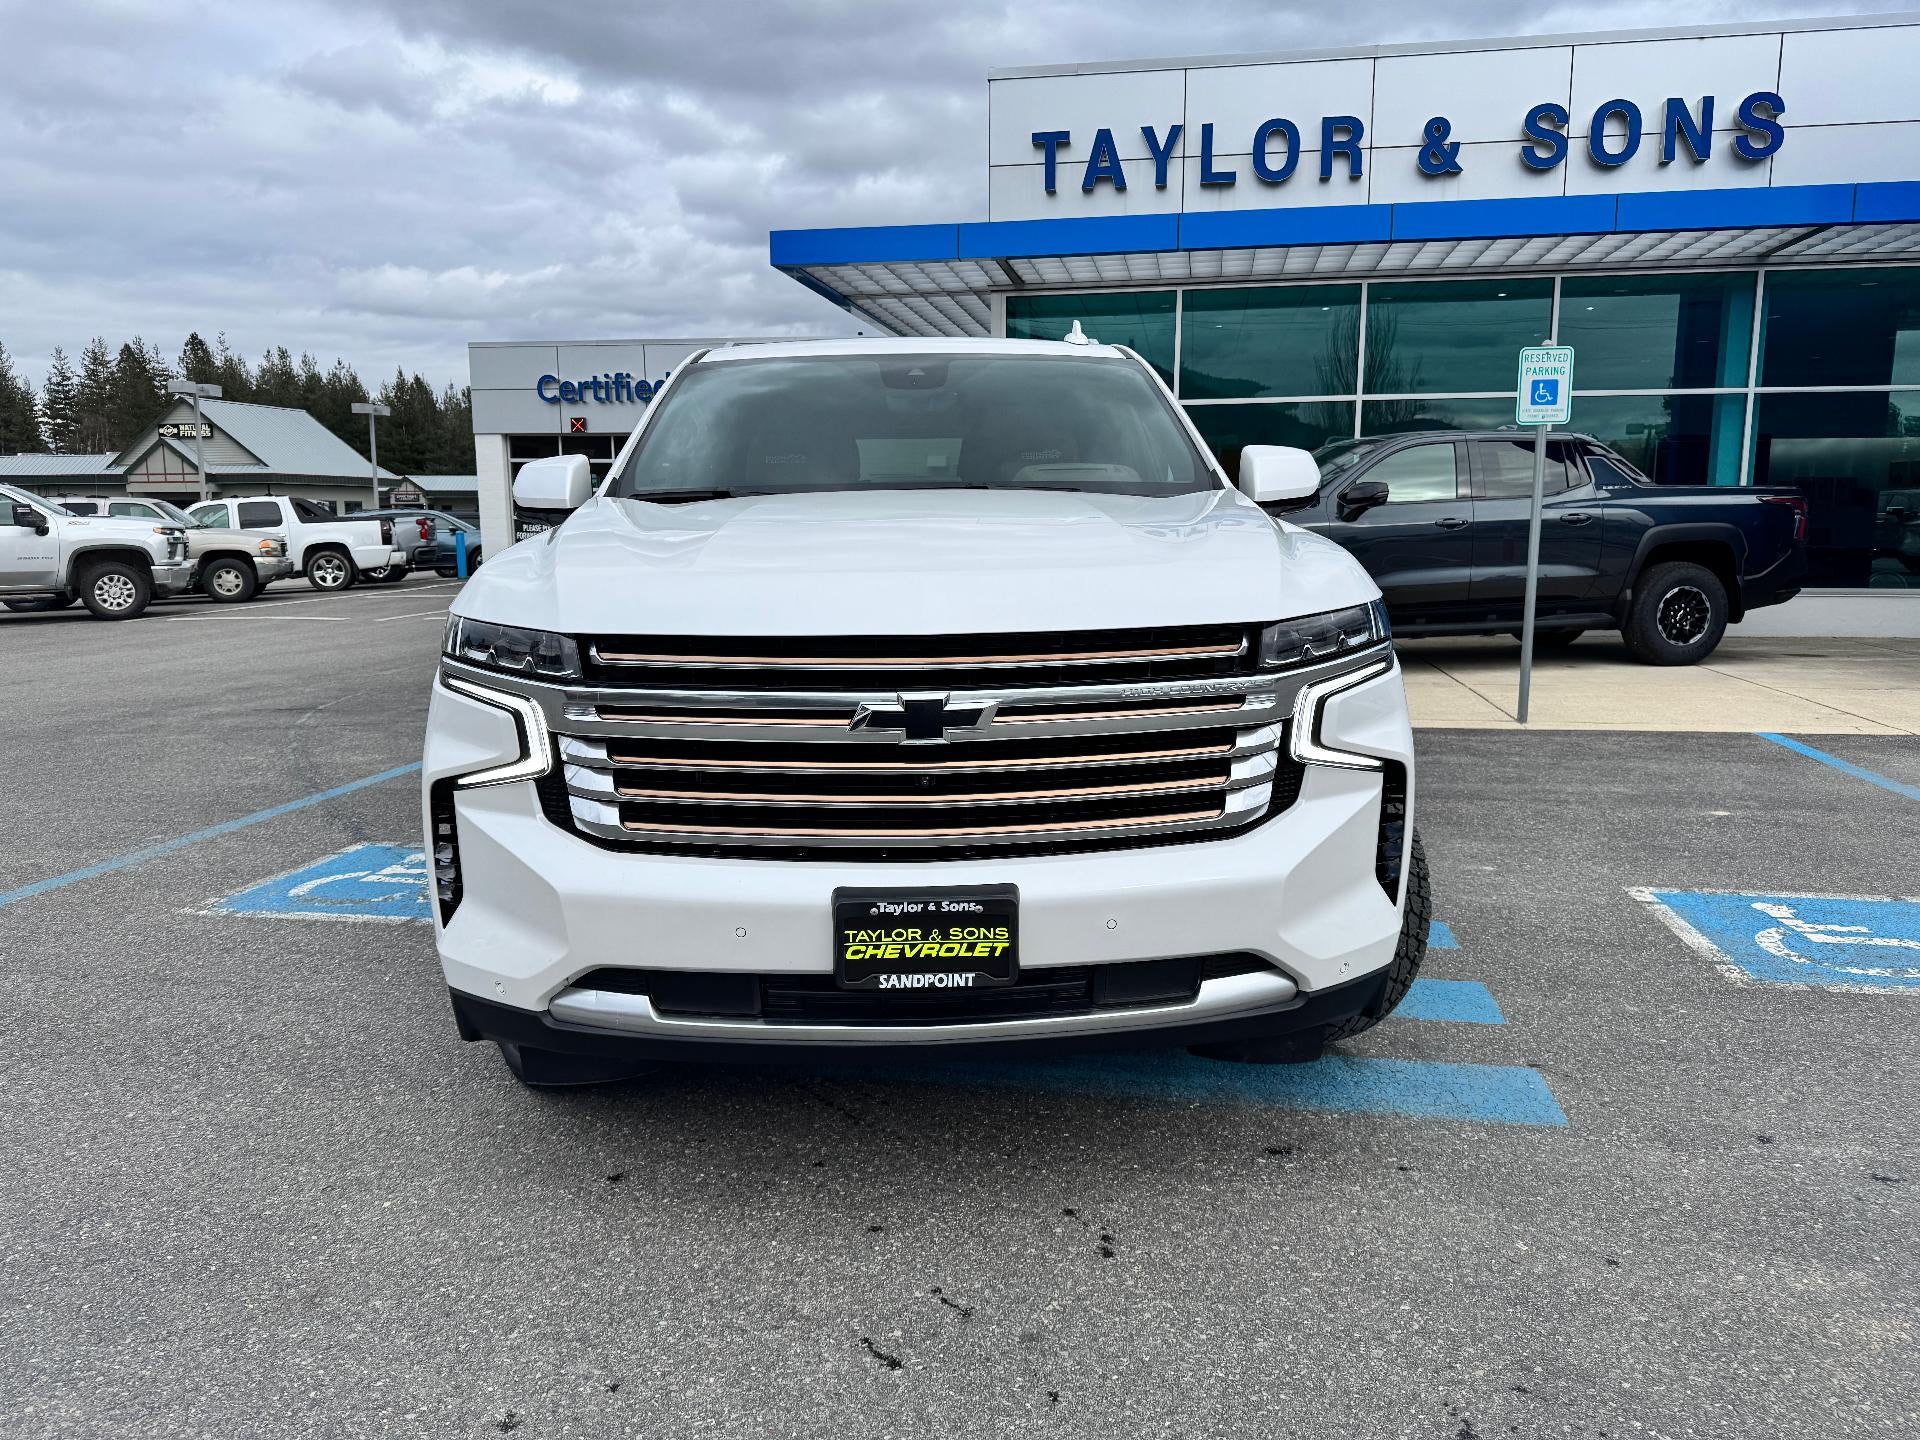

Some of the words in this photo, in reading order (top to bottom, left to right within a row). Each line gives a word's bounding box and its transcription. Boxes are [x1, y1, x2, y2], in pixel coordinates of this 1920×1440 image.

[1030, 115, 1366, 194] TAYLOR
[1417, 116, 1464, 176] &
[1519, 91, 1787, 172] SONS
[1524, 353, 1569, 363] RESERVED
[1525, 366, 1566, 376] PARKING
[523, 524, 542, 532] PLEASE
[877, 902, 923, 915] Taylor
[928, 903, 936, 911] &
[941, 901, 976, 911] Sons
[844, 928, 921, 942] TAYLOR
[929, 929, 942, 942] &
[950, 927, 1009, 939] SONS
[845, 943, 1010, 960] CHEVROLET
[879, 973, 976, 989] SANDPOINT
